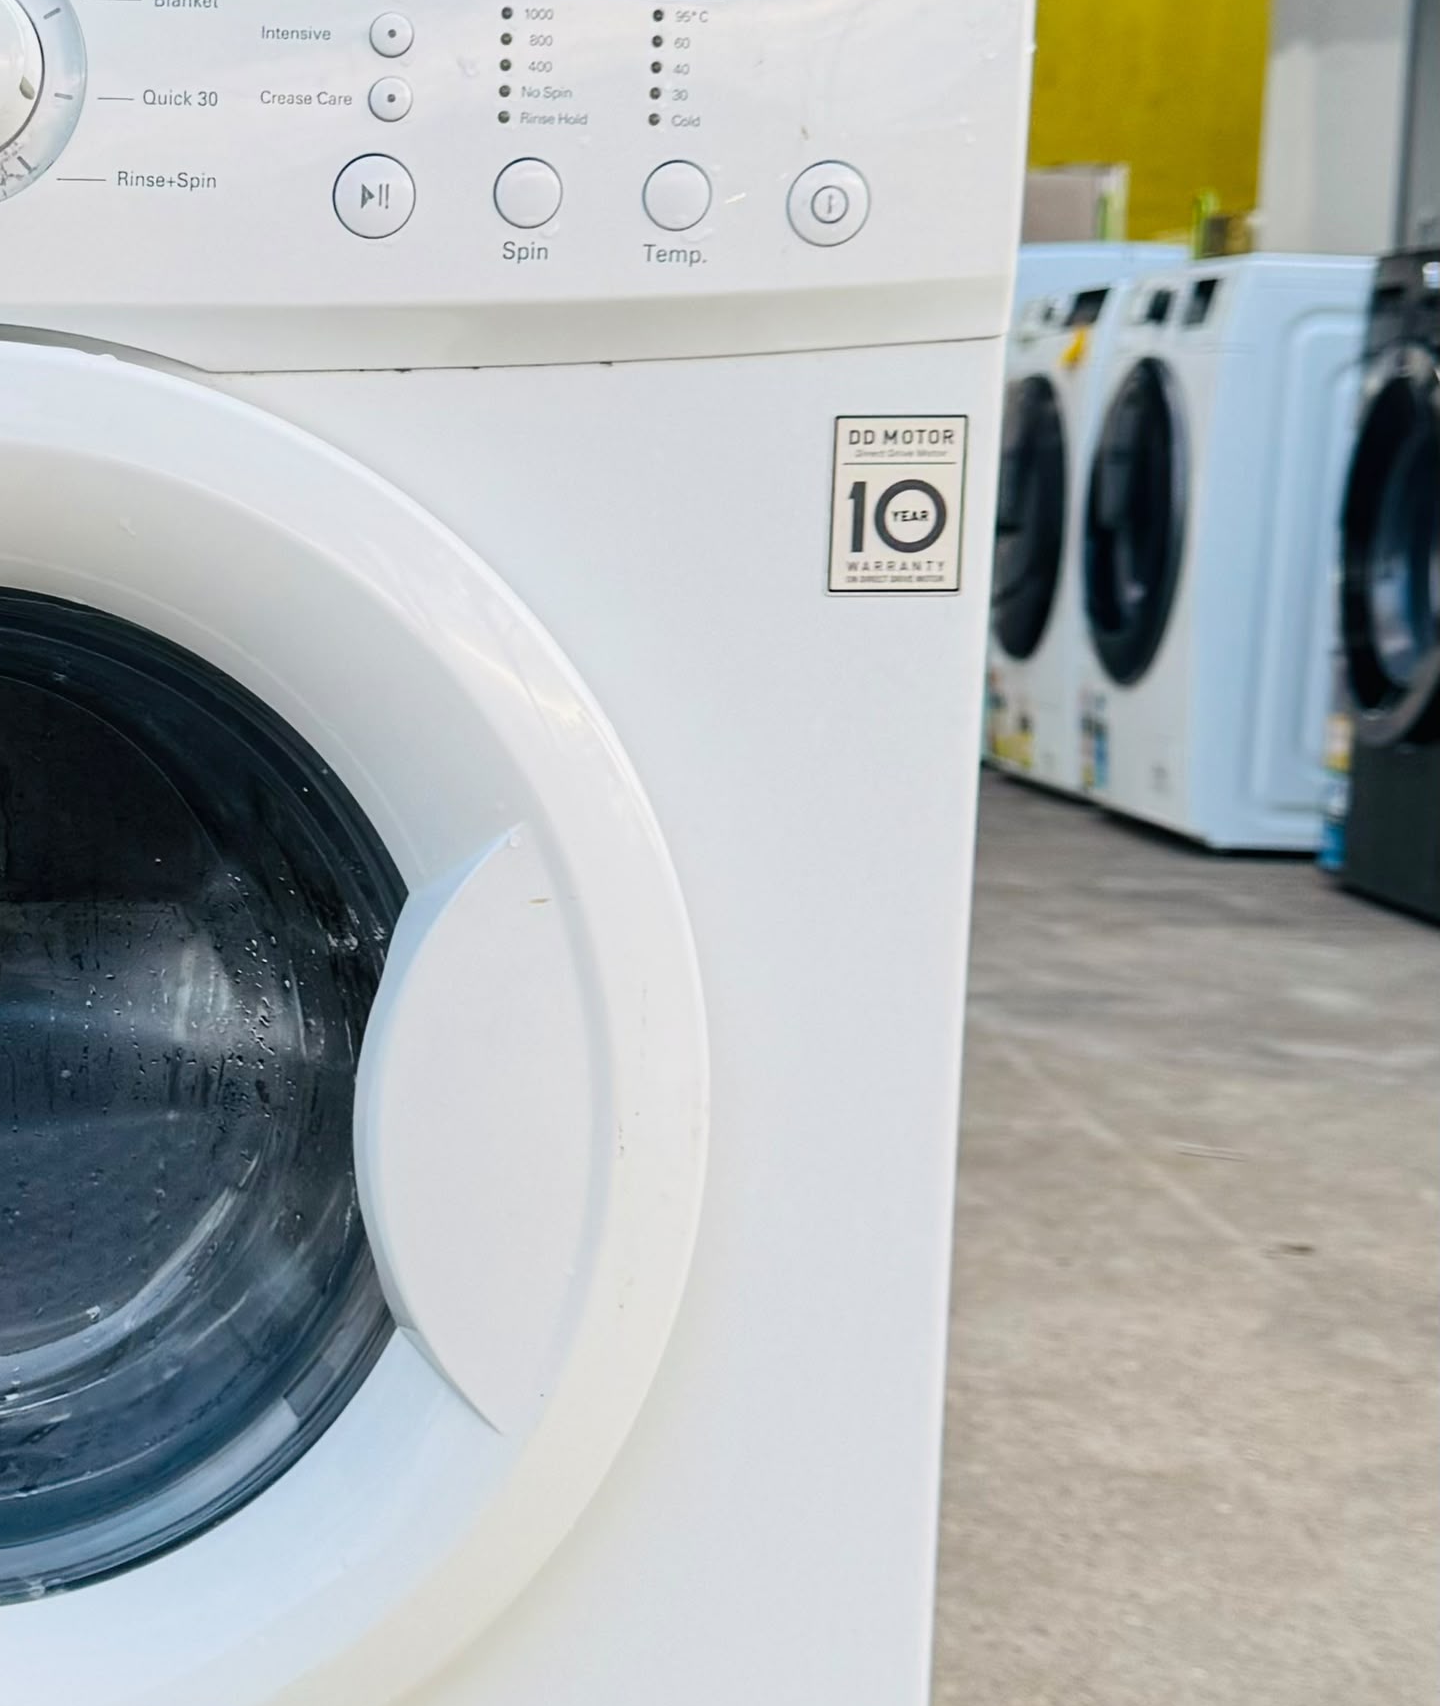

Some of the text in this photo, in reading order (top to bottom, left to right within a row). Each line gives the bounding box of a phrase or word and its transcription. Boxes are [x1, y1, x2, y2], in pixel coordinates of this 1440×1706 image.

[525, 8, 554, 20] 1000
[261, 25, 332, 41] Intensive
[529, 34, 553, 47] 800
[674, 37, 691, 49] 60
[528, 61, 552, 73] 400
[673, 63, 690, 75] 40
[142, 90, 219, 108] Quick 30
[260, 90, 353, 106] Crease Care
[521, 86, 573, 101] No Spin
[672, 89, 689, 101] 30
[520, 111, 588, 125] Rinse Hold
[671, 115, 701, 127] Cold
[117, 171, 218, 191] Rinse+Spin
[502, 241, 549, 263] Spin
[643, 244, 708, 266] Temp.
[849, 429, 955, 445] DD MOTOR
[848, 479, 947, 553] 10
[892, 510, 930, 522] YEAR
[846, 560, 945, 571] WARRANTY
